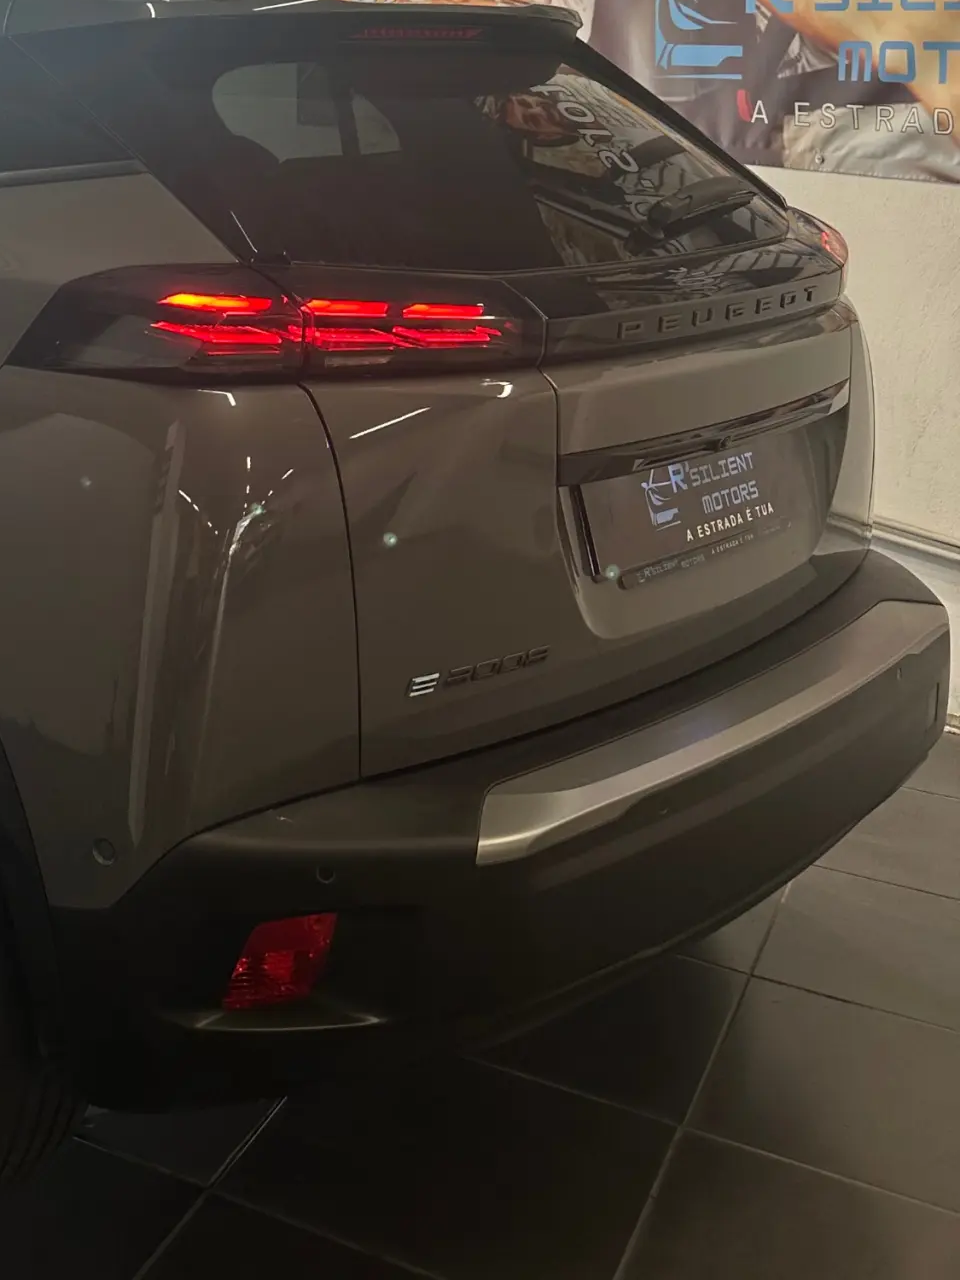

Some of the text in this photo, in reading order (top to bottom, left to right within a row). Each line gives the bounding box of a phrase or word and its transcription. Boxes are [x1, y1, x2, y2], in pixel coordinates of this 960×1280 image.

[751, 100, 954, 136] A ESTRAD
[617, 285, 818, 340] PEUGEOT
[667, 452, 753, 493] R'SILIENT
[701, 480, 759, 514] MOTORS
[686, 502, 775, 542] A ESTRADA É TUA
